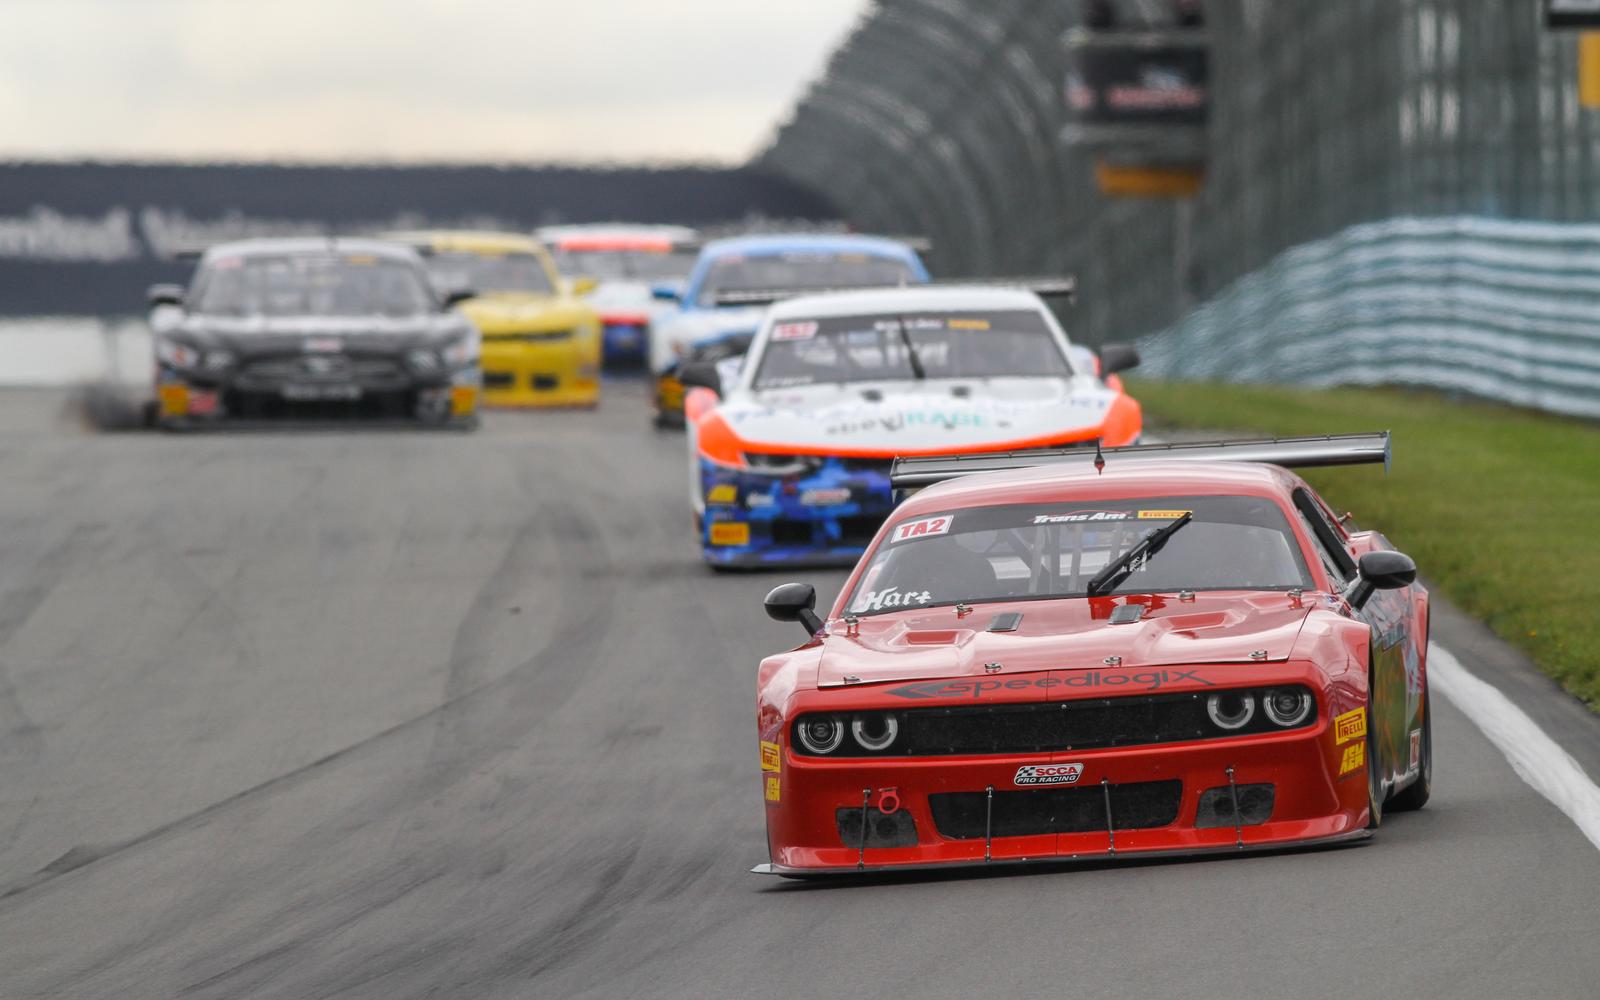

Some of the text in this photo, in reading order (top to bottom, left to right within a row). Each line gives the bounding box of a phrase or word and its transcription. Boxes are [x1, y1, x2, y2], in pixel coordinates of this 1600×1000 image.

[1033, 512, 1127, 524] Trans Am
[1142, 510, 1190, 518] PIRELL
[900, 518, 946, 539] TA2
[864, 586, 932, 612] Hart
[936, 669, 1216, 697] speedlogix
[1338, 712, 1363, 739] PIRELLI
[1035, 767, 1078, 776] SCCA
[1039, 775, 1077, 783] RACING
